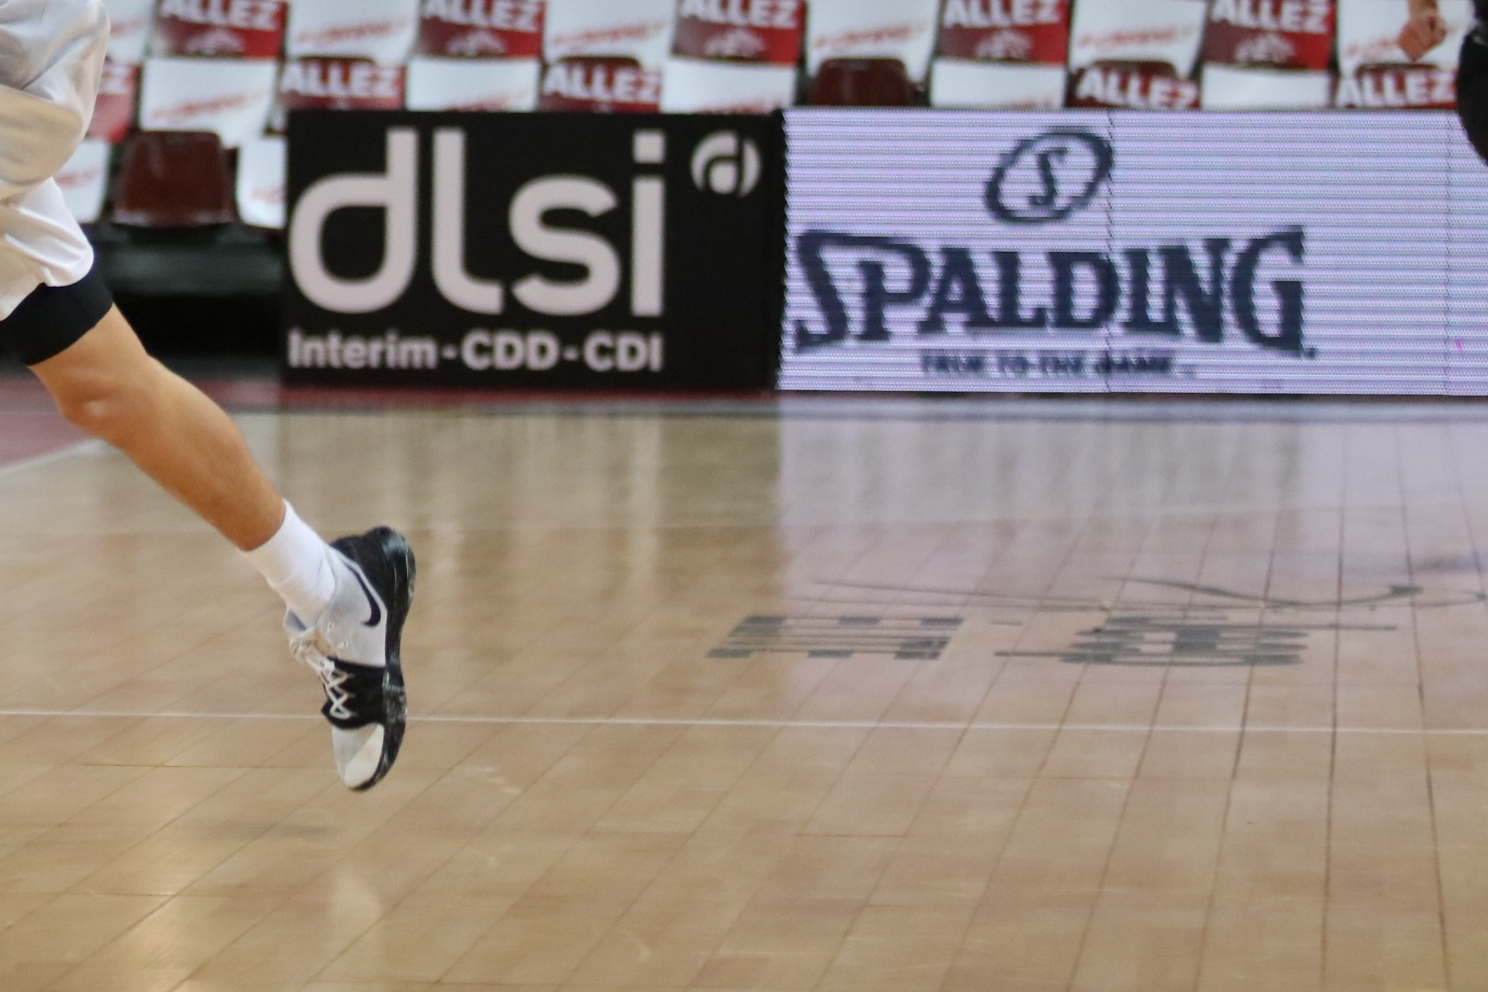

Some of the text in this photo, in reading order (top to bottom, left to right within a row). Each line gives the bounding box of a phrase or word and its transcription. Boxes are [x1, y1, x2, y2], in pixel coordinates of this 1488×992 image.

[281, 60, 400, 99] ALLEZ
[544, 63, 661, 104] ALLEZ
[1073, 69, 1199, 109] ALLEZ
[1335, 68, 1458, 108] ALLEZ
[288, 125, 666, 316] dlsi
[793, 225, 1307, 358] SPALDING
